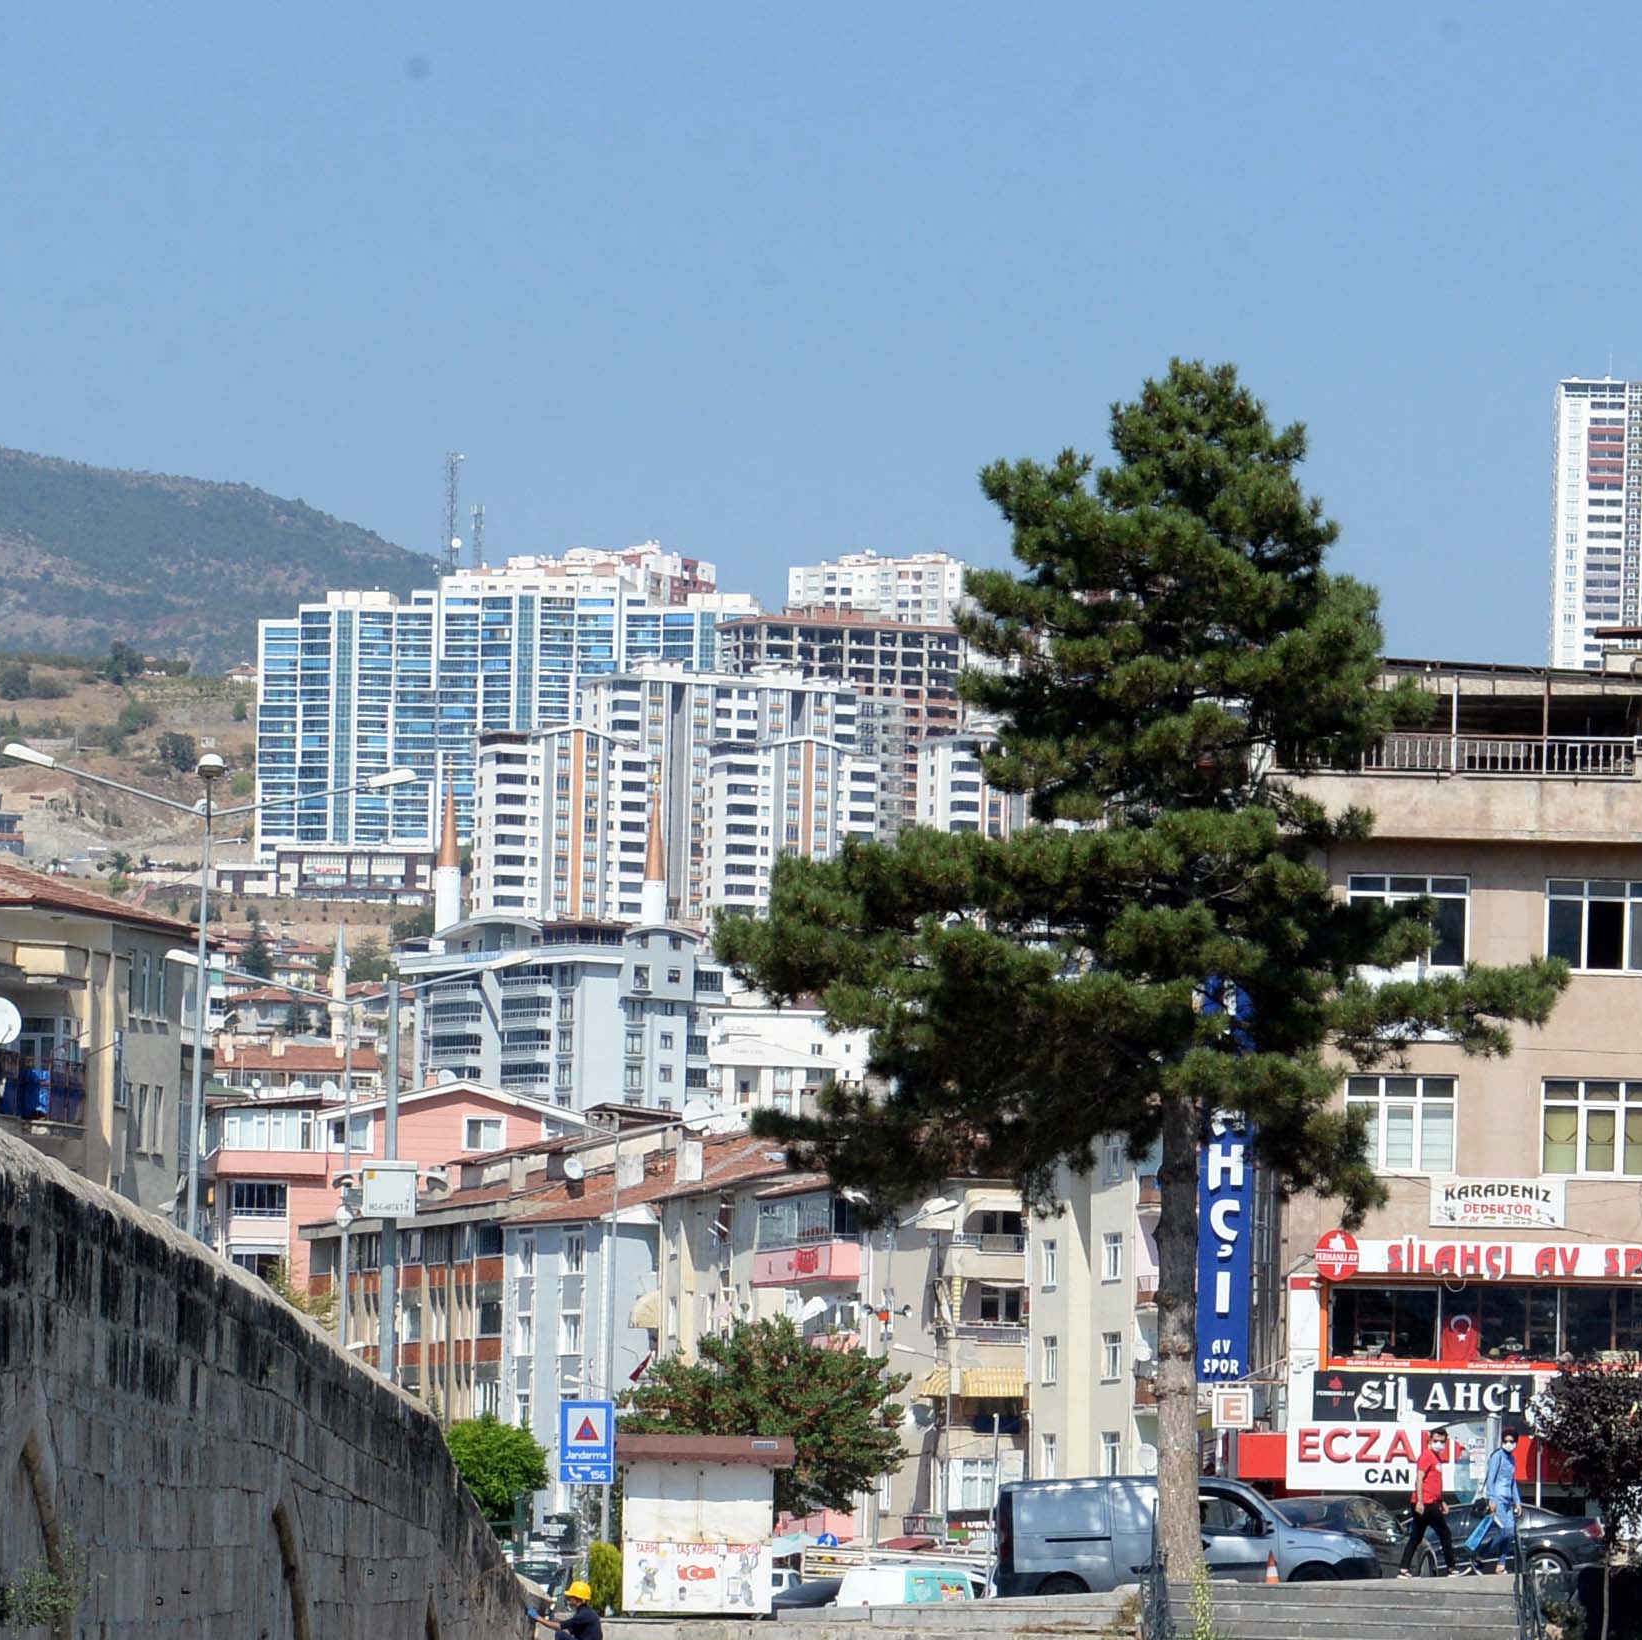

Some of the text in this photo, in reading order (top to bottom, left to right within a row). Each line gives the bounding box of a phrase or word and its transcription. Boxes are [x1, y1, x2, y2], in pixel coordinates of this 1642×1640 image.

[1443, 1184, 1553, 1204] KARADENİZ
[1463, 1202, 1533, 1216] DEDEKTÖR
[1388, 1236, 1511, 1281] SİLAHÇI
[1535, 1246, 1580, 1277] AV
[1212, 1338, 1232, 1355] AV
[1202, 1358, 1240, 1376] SPOR
[1223, 1397, 1243, 1421] E
[564, 1449, 607, 1460] Jandarma
[590, 1470, 607, 1480] 156
[1364, 1468, 1410, 1485] CAN
